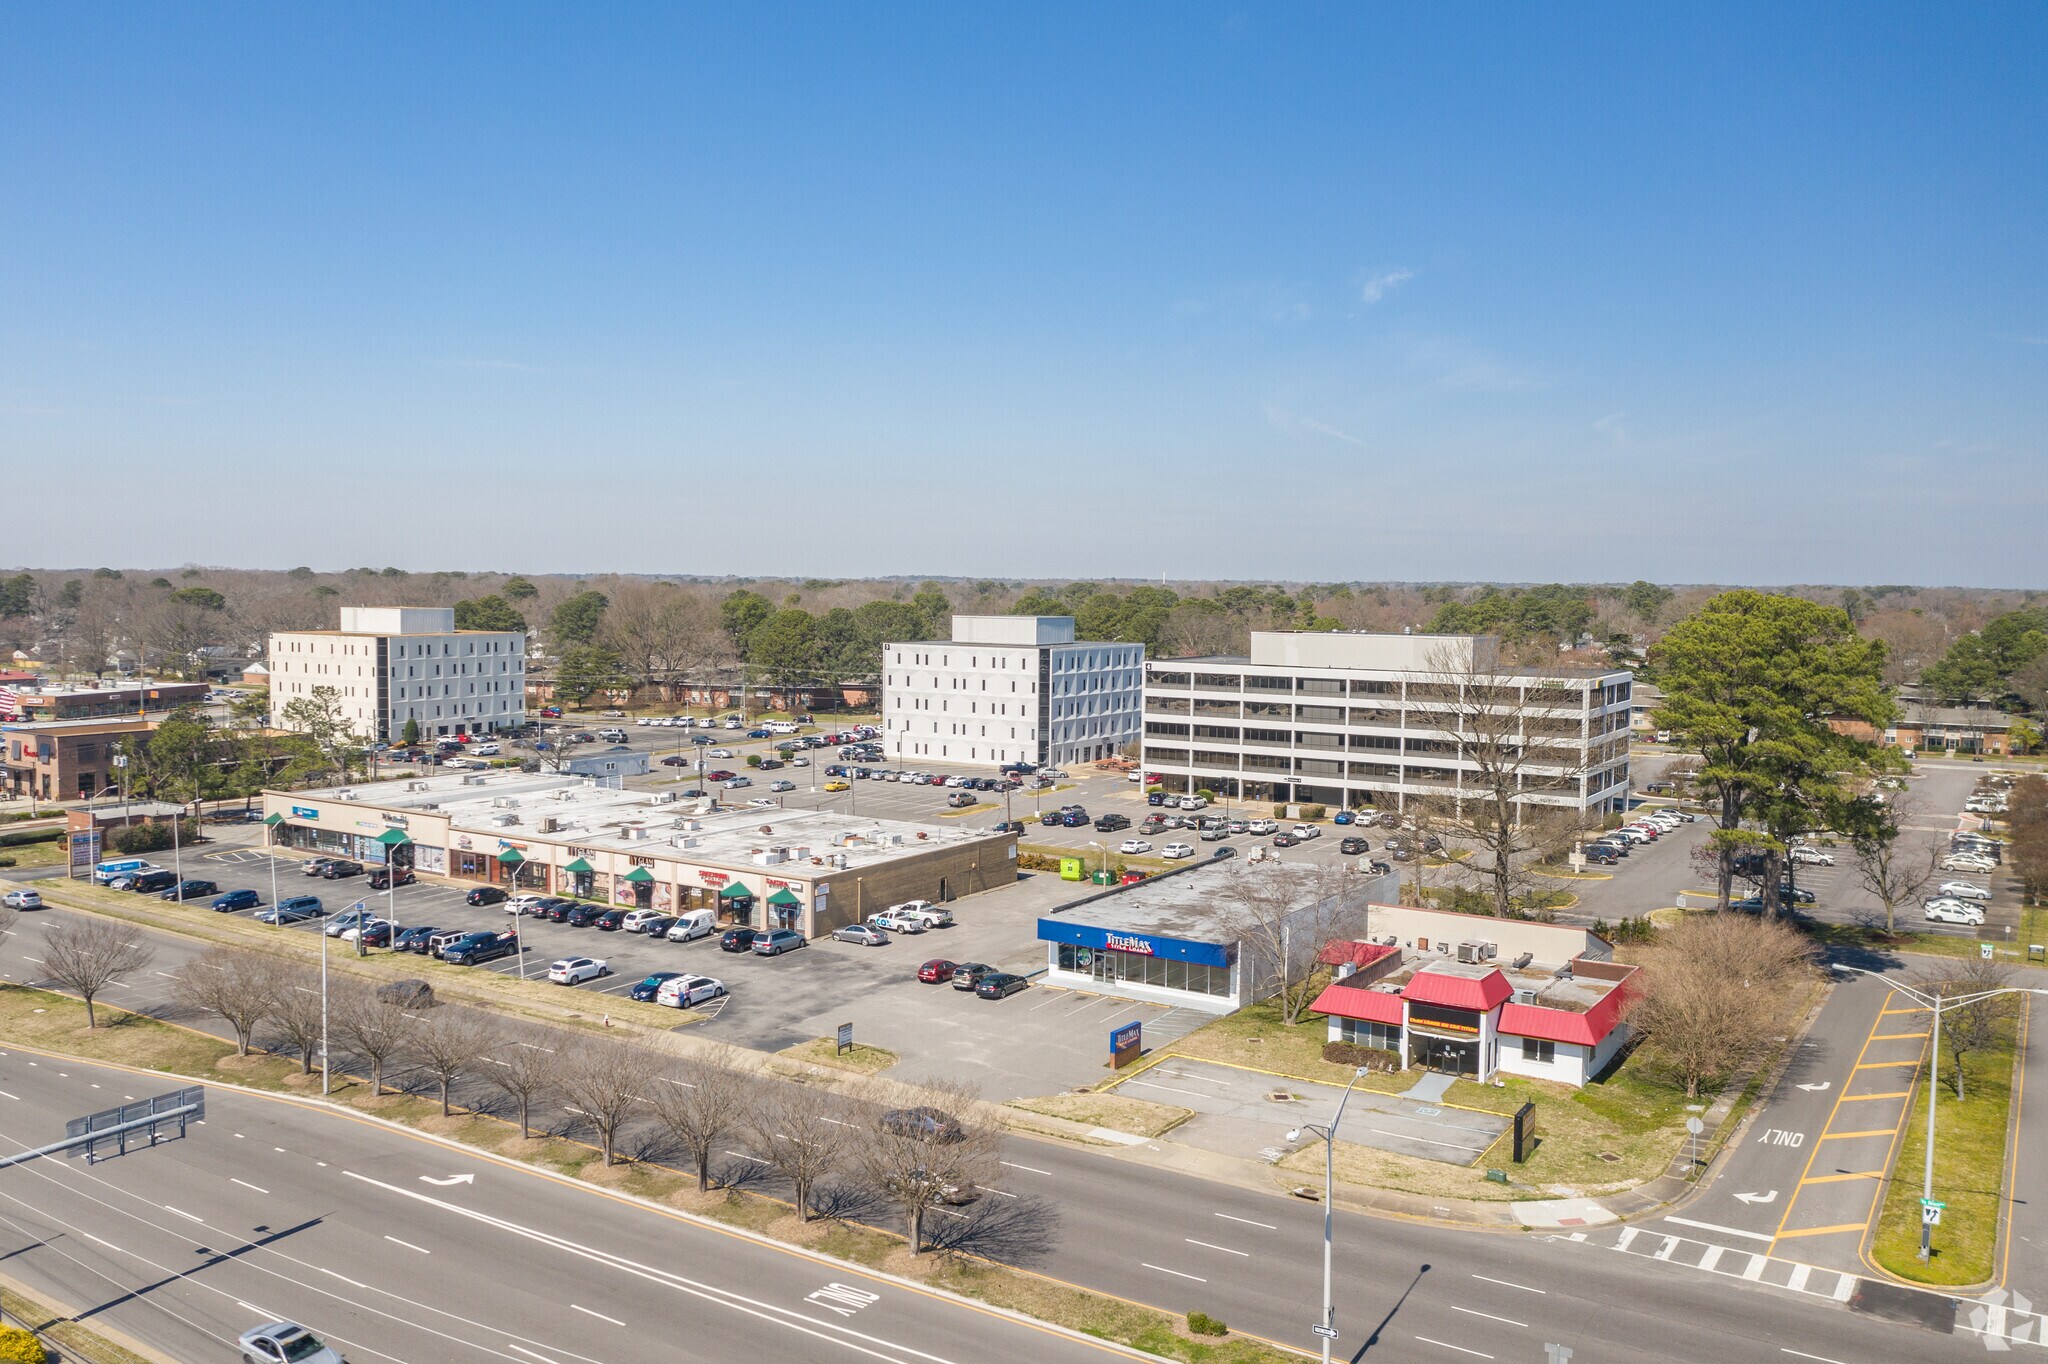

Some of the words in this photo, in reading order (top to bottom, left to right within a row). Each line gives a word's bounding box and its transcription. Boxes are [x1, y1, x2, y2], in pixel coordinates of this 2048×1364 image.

[1106, 933, 1152, 952] TITLEMAX
[1117, 1029, 1140, 1043] TITLEMAX
[1757, 1128, 1804, 1147] ONLY
[803, 1282, 880, 1317] ONLY
